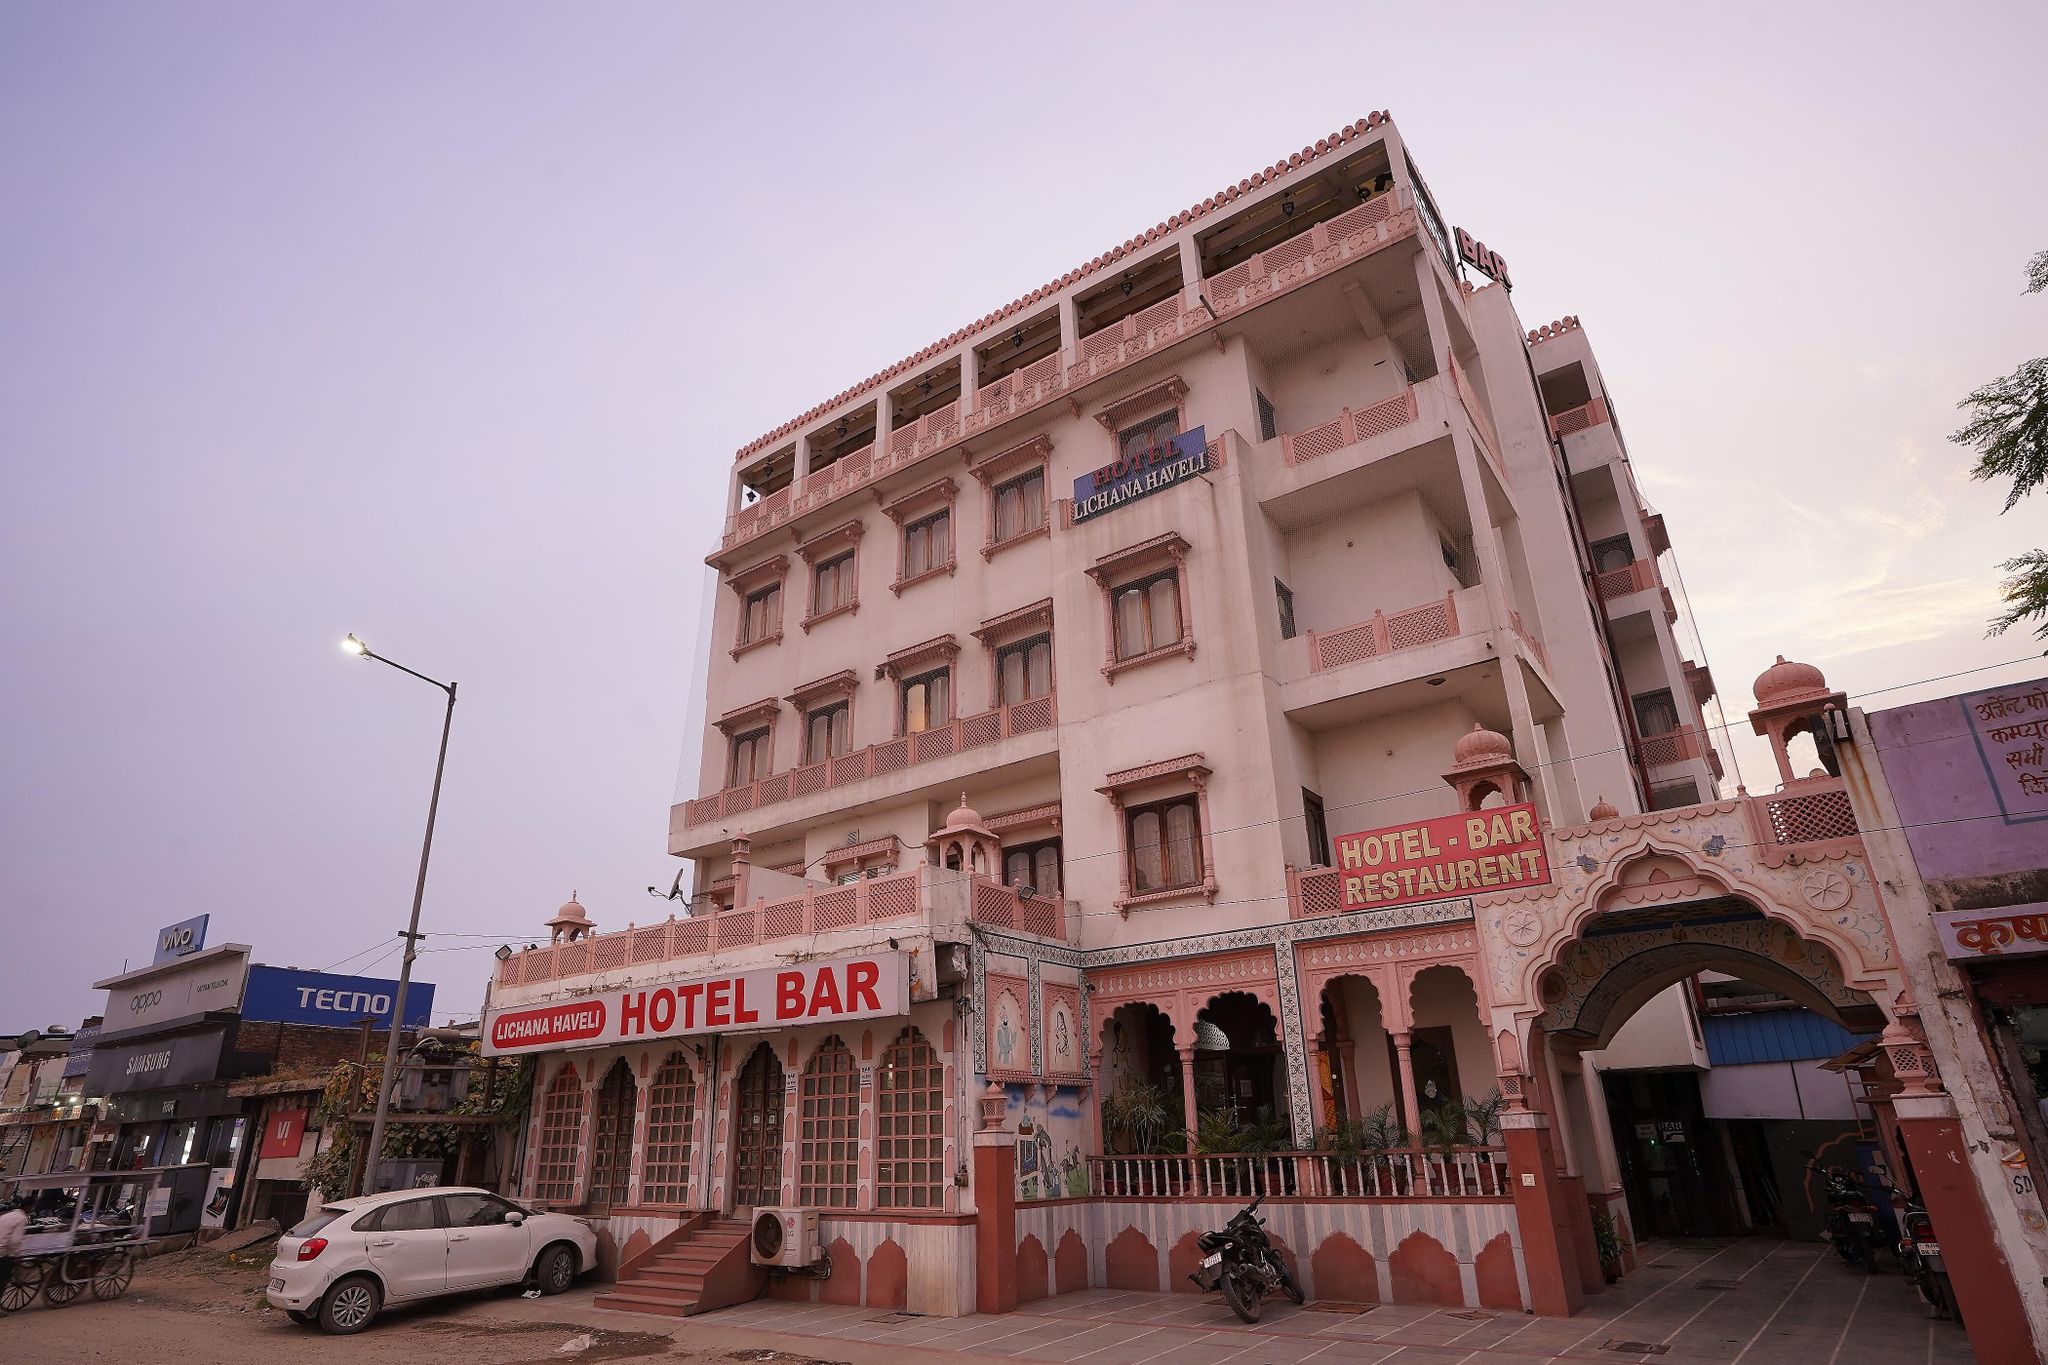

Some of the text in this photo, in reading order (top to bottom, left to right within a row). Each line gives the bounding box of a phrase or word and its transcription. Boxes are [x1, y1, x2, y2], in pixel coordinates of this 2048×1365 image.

[1456, 227, 1513, 288] BAR
[1093, 440, 1183, 488] HOTEL
[1073, 451, 1206, 520] LICHANA HAVELI
[2006, 742, 2045, 770] सभी
[1341, 826, 1441, 870] HOTEL
[1466, 809, 1537, 850] BAR
[1345, 849, 1541, 905] RESTAURENT
[163, 926, 193, 951] vivo
[130, 989, 162, 1015] oppo
[297, 987, 391, 1014] TECNO
[620, 961, 882, 1036] HOTEL BAR
[496, 1010, 600, 1040] LICHANA HAVELI
[126, 1050, 171, 1075] SAMSUNG
[1659, 1121, 1682, 1131] BAR
